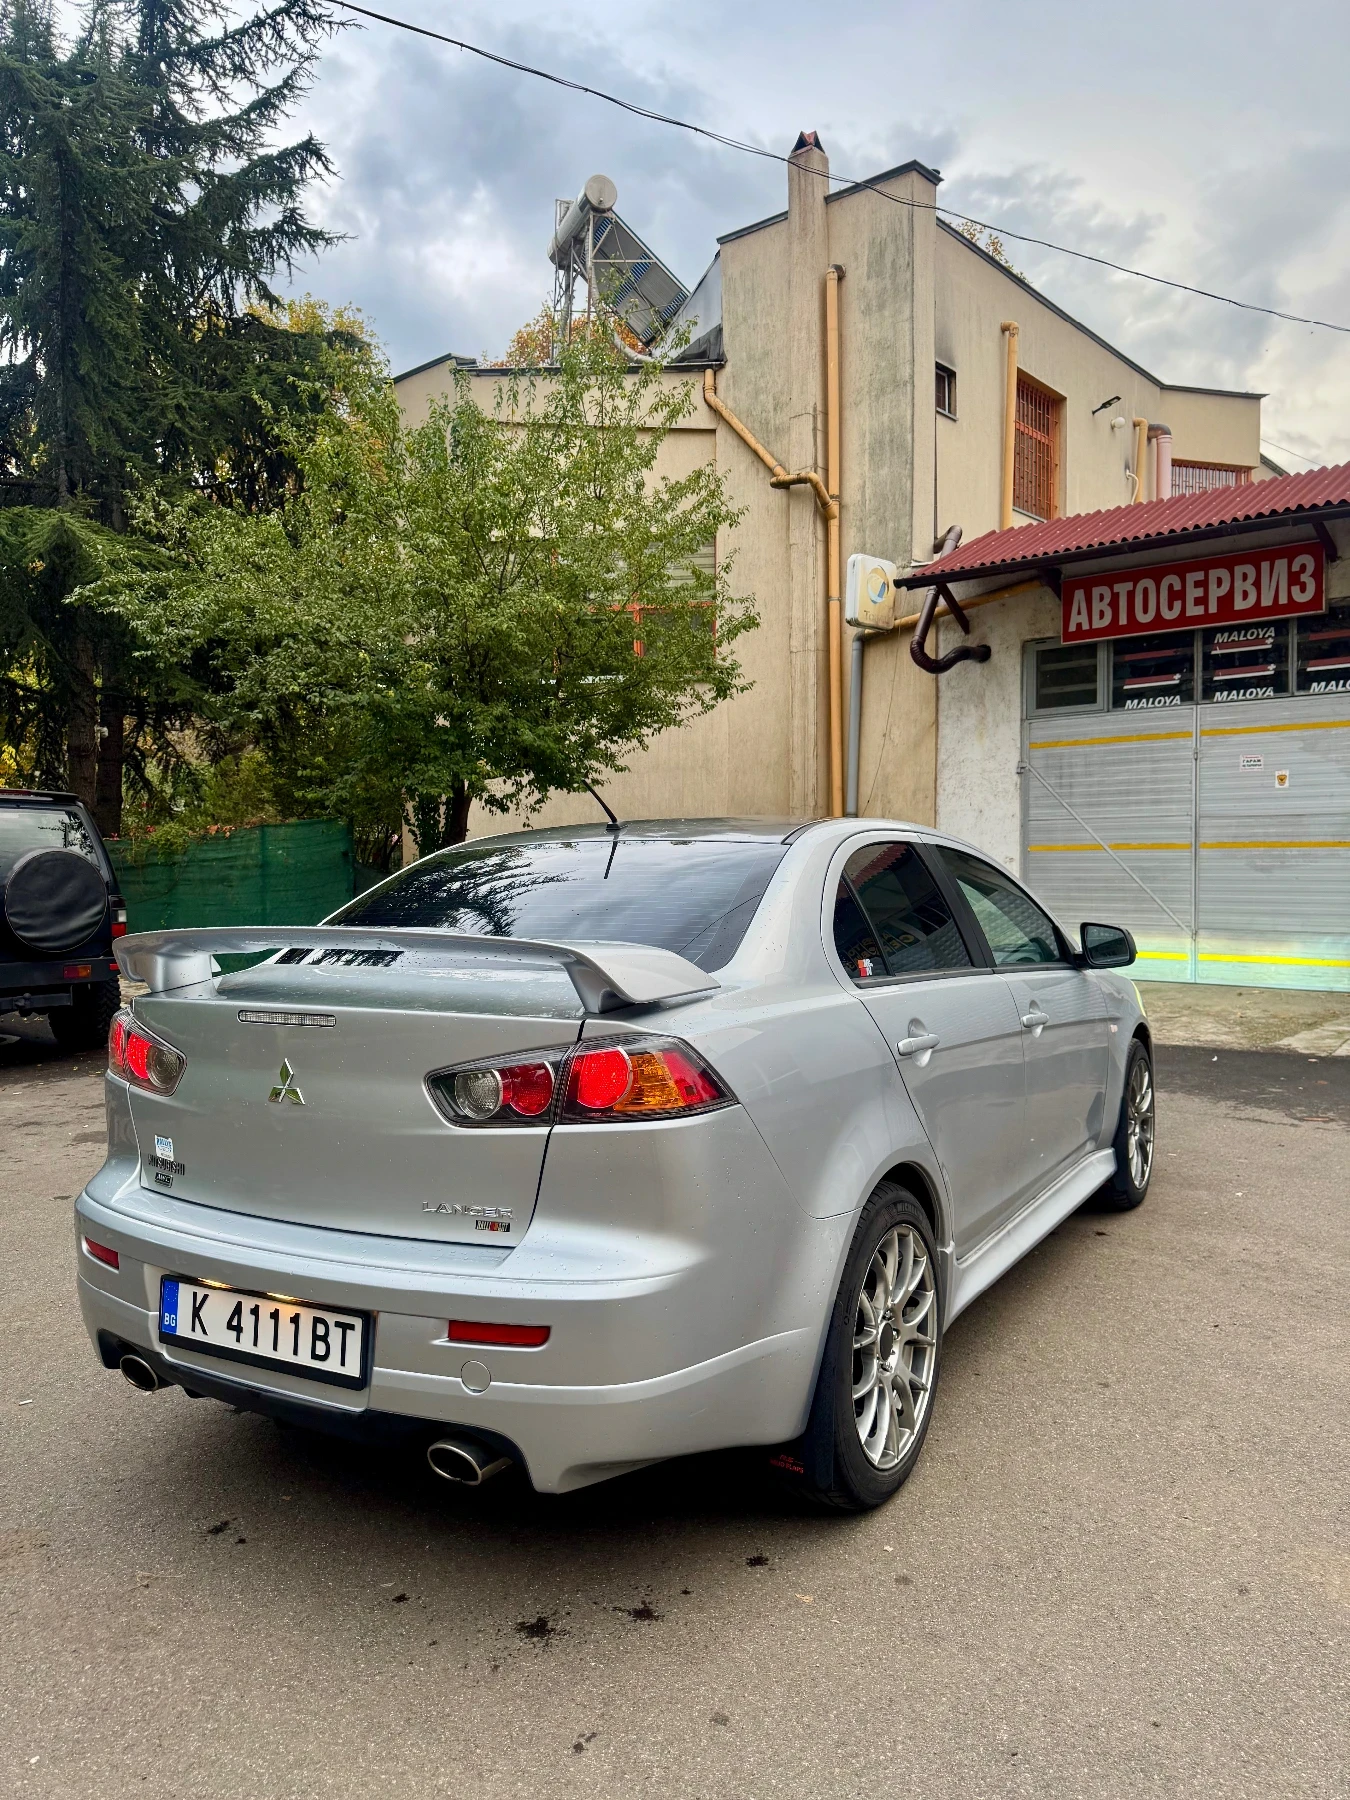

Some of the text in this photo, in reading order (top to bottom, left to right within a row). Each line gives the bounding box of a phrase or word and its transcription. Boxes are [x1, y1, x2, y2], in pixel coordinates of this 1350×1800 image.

[1068, 554, 1316, 633] АВТОСЕРВИЗ
[1214, 626, 1276, 644] MALOYA
[1124, 695, 1181, 710] MALOYA
[1213, 687, 1275, 703] MALOYA
[422, 1201, 514, 1219] LANCER
[164, 1313, 176, 1326] BG
[191, 1291, 209, 1335] K
